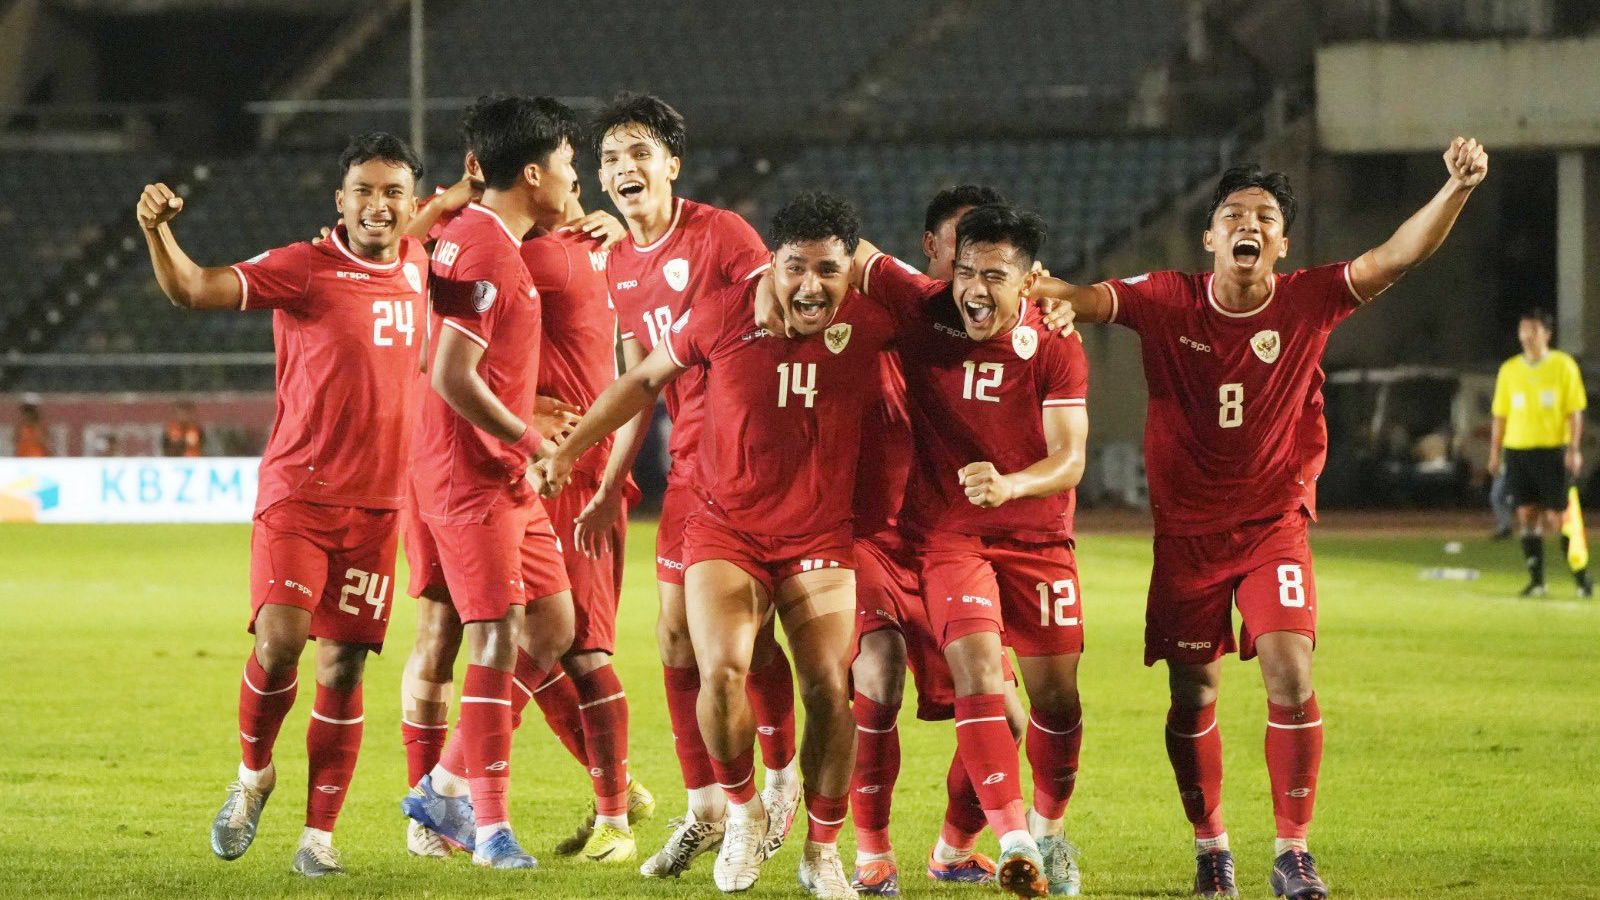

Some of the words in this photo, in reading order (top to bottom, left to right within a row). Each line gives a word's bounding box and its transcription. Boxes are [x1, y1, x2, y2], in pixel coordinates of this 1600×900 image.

[336, 271, 370, 280] erspo
[616, 279, 638, 291] erspo
[372, 300, 415, 346] 24
[642, 305, 673, 350] 18
[933, 322, 968, 339] erspo
[1179, 335, 1211, 353] erspo
[777, 362, 819, 408] 14
[962, 360, 1005, 403] 12
[1218, 382, 1244, 429] 8
[101, 465, 258, 503] KBZM
[338, 567, 390, 620] 24
[1035, 579, 1078, 626] 12
[1277, 564, 1305, 608] 8
[1177, 640, 1212, 651] erspo
